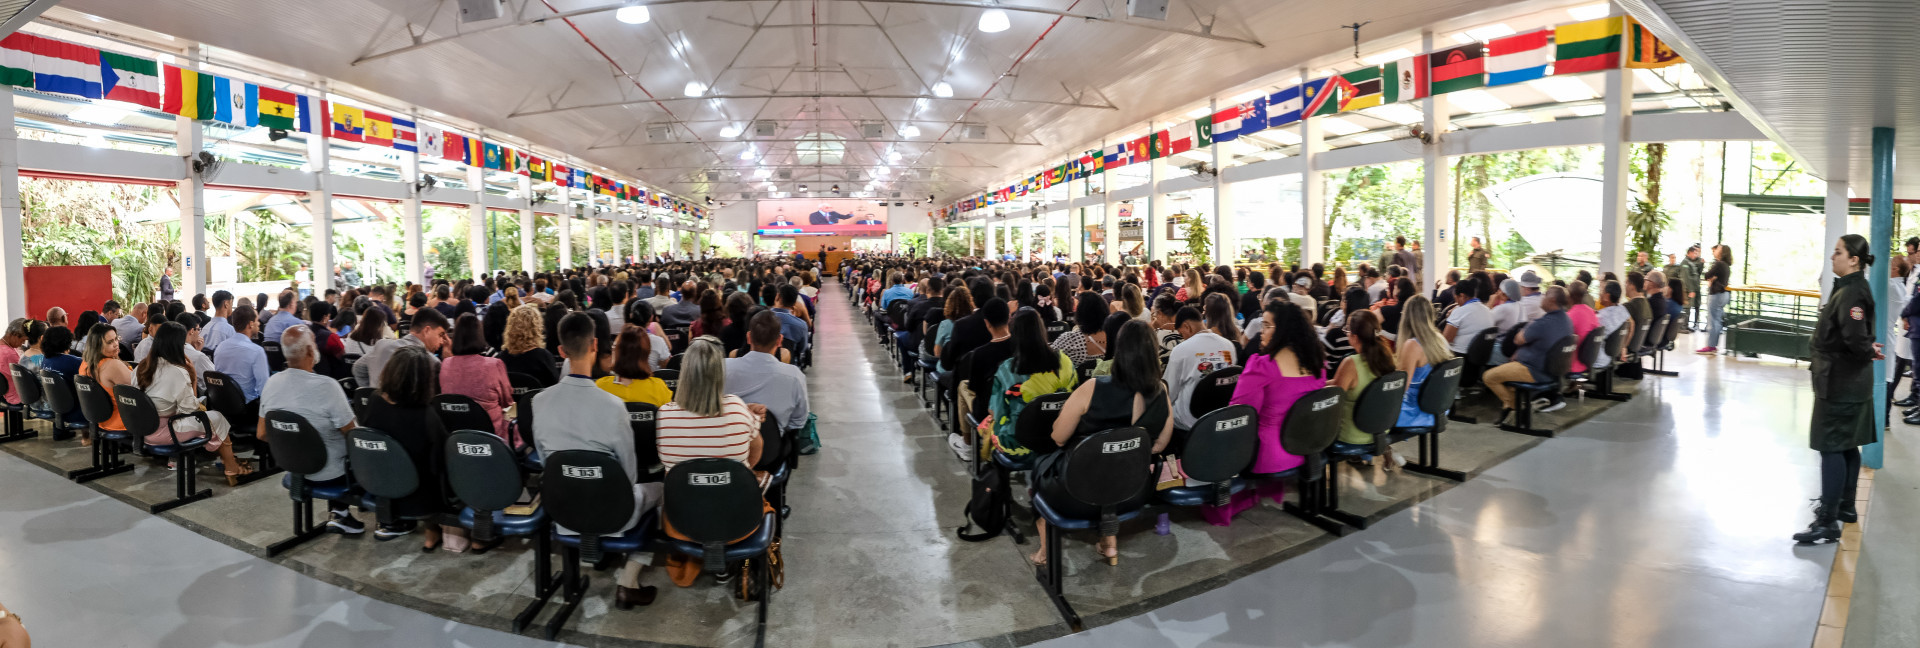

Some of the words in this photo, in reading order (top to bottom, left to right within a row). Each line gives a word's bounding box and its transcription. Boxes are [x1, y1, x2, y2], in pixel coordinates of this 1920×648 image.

[1439, 229, 1446, 239] E
[186, 257, 192, 267] E
[1119, 440, 1136, 450] 140
[568, 467, 573, 475] E
